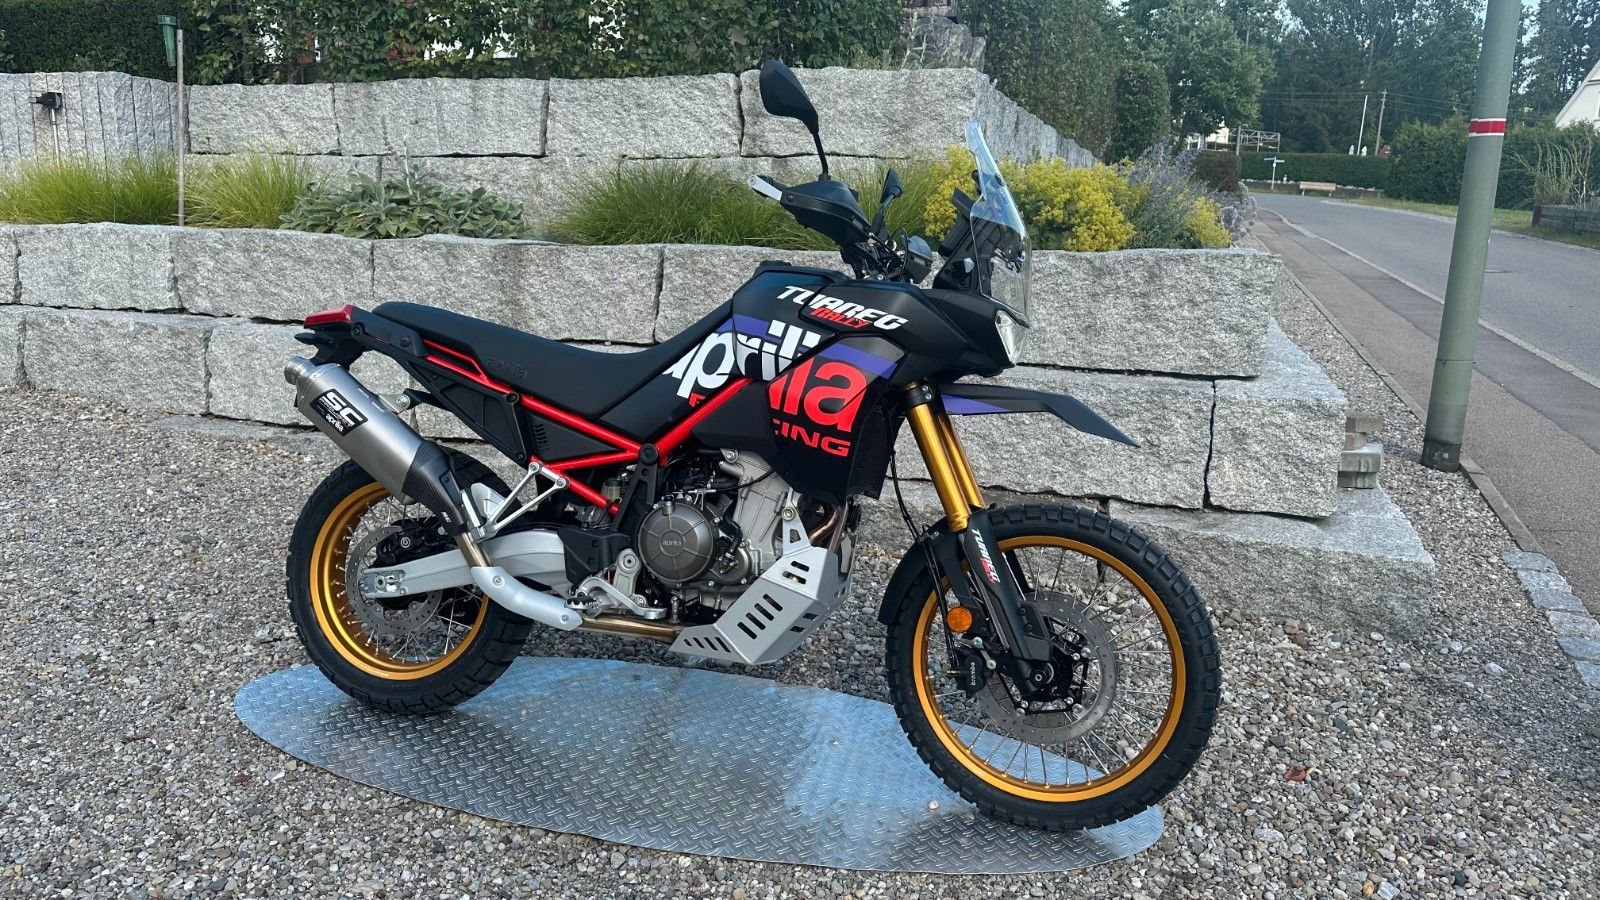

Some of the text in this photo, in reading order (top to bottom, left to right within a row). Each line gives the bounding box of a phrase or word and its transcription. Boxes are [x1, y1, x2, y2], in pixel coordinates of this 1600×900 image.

[777, 285, 908, 330] TUAREG
[810, 307, 872, 329] RALLY
[319, 391, 364, 426] SC
[325, 413, 344, 432] aprilia
